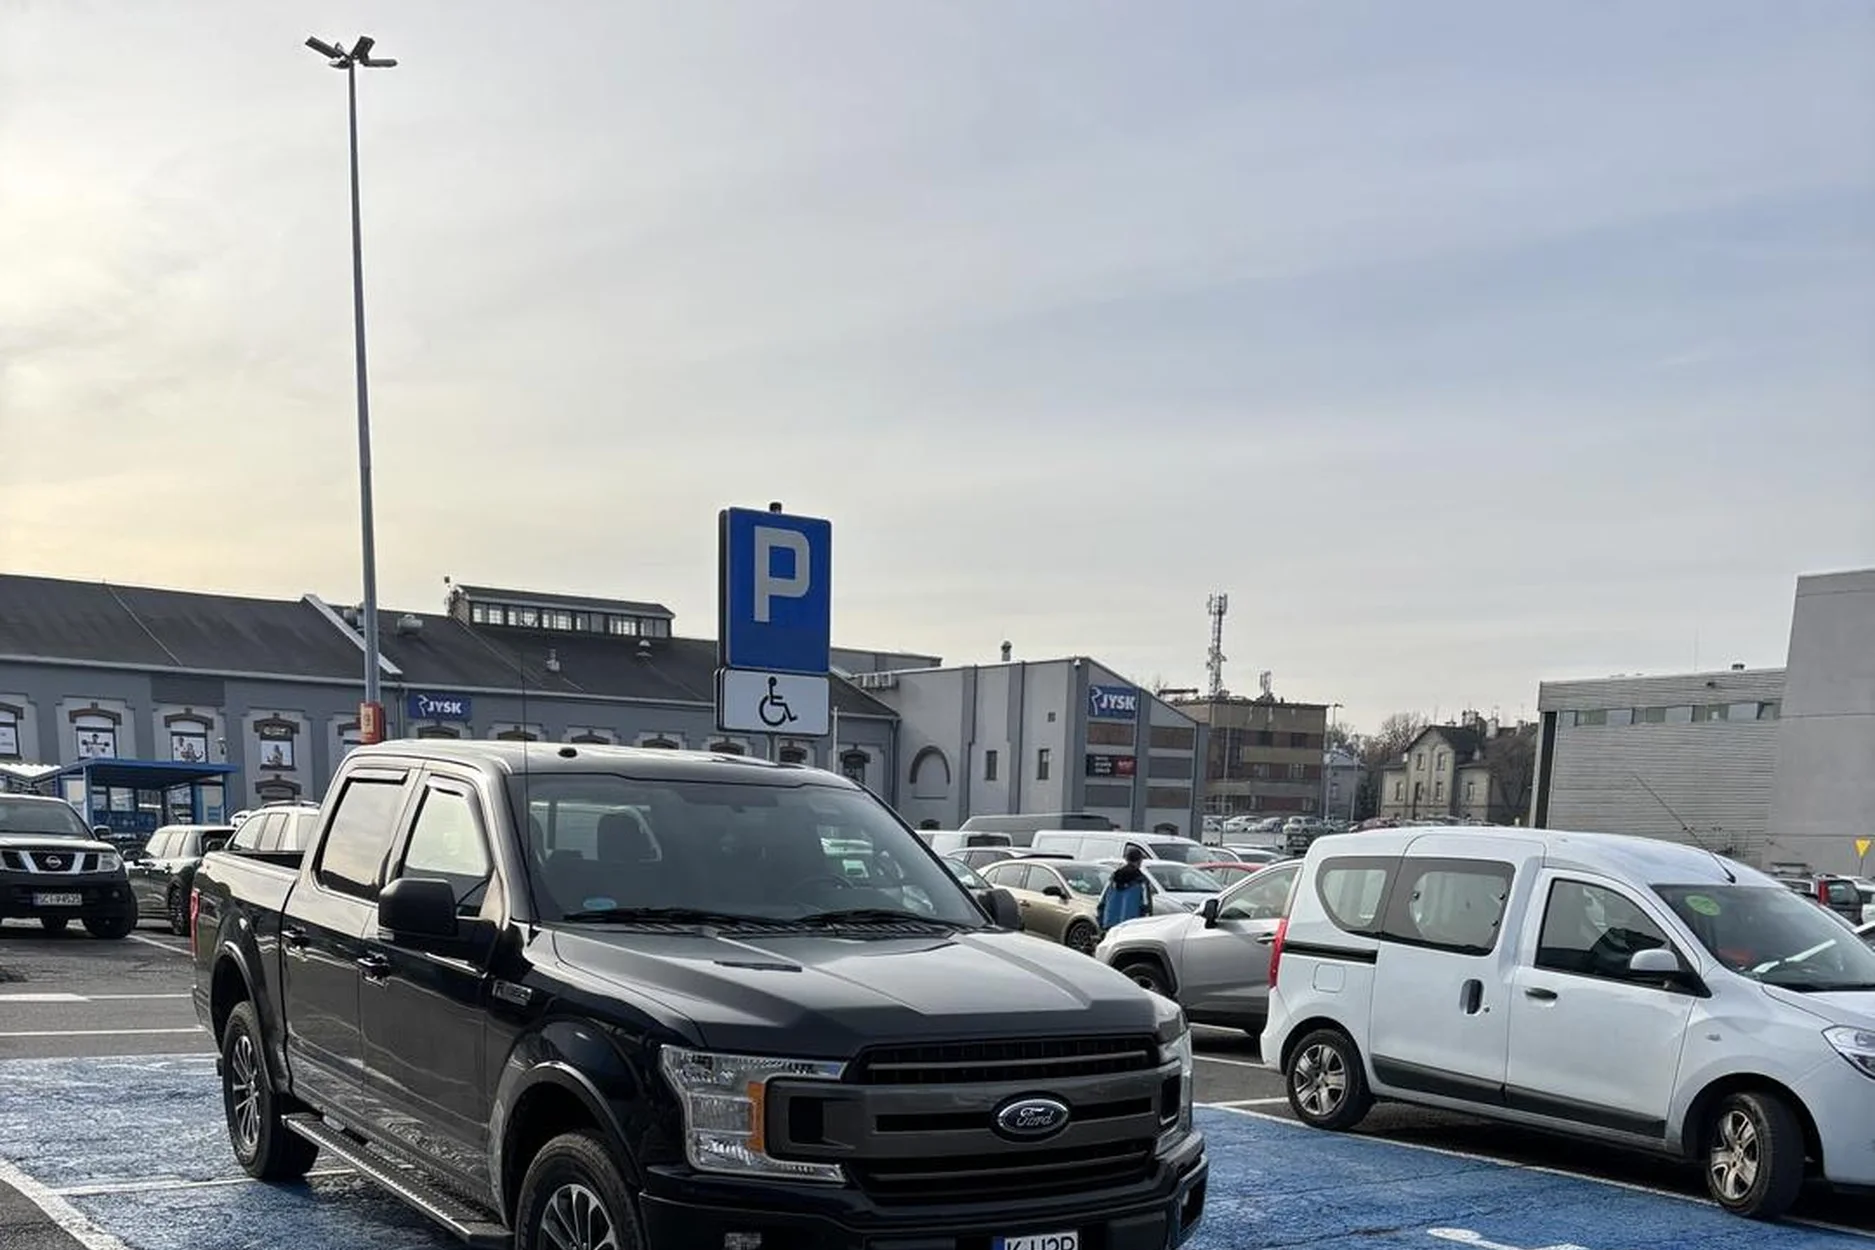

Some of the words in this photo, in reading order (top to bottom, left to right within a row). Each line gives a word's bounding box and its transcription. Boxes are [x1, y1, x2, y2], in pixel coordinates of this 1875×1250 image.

[754, 525, 810, 622] P
[427, 700, 462, 714] JYSK
[1100, 693, 1135, 711] JYSK
[1016, 1107, 1053, 1126] Ford
